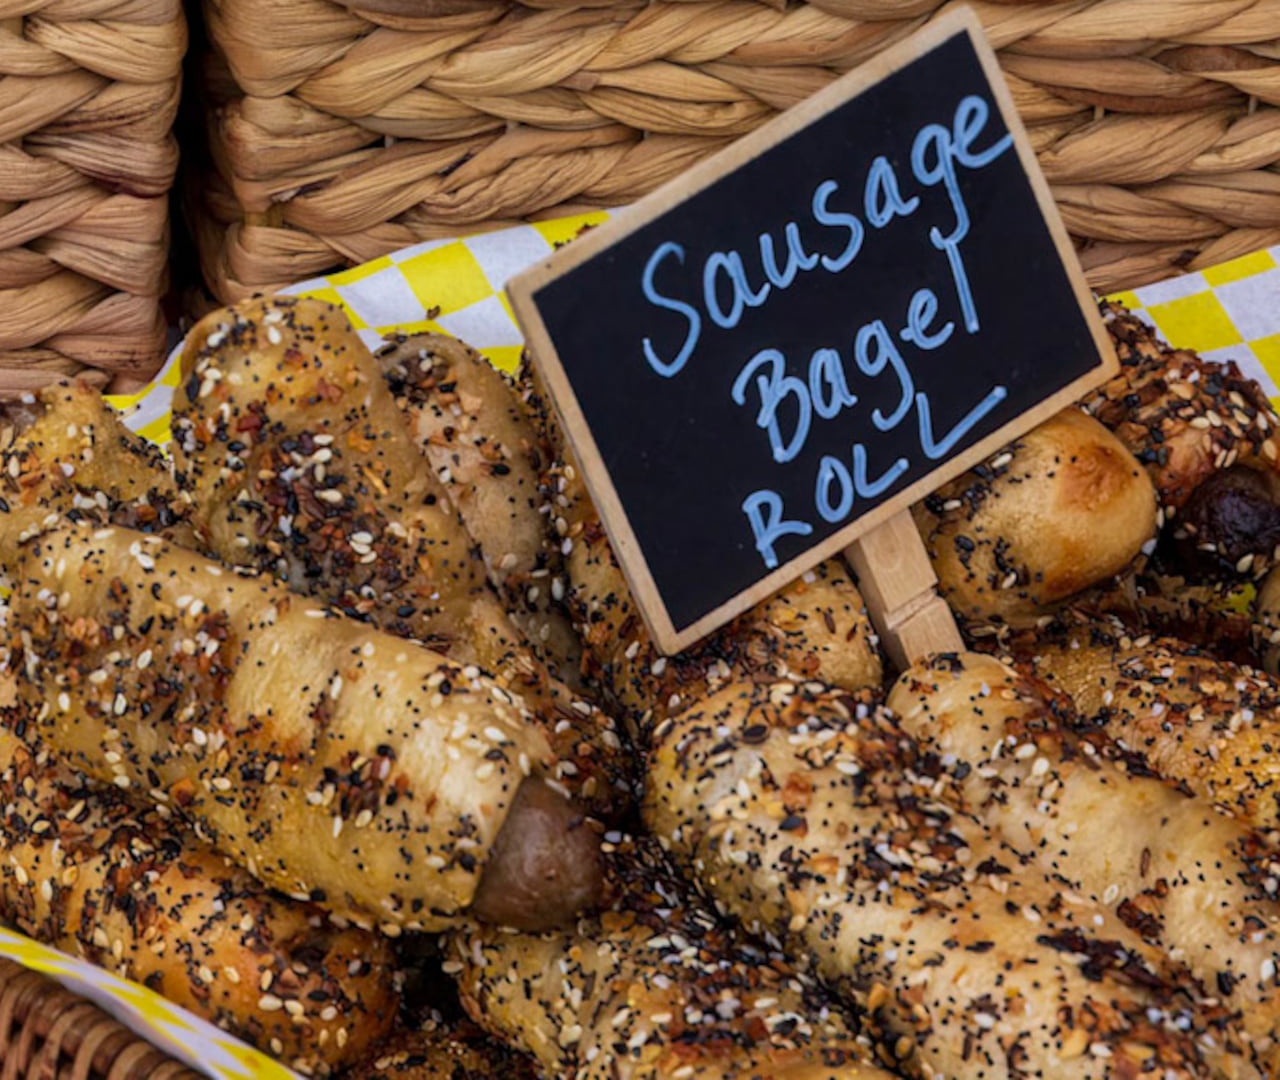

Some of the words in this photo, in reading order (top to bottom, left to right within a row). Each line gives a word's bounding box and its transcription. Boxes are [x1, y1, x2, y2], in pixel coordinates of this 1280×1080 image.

[642, 94, 1017, 378] Sausage
[732, 230, 980, 463] Bagel
[742, 384, 1007, 569] ROLL
